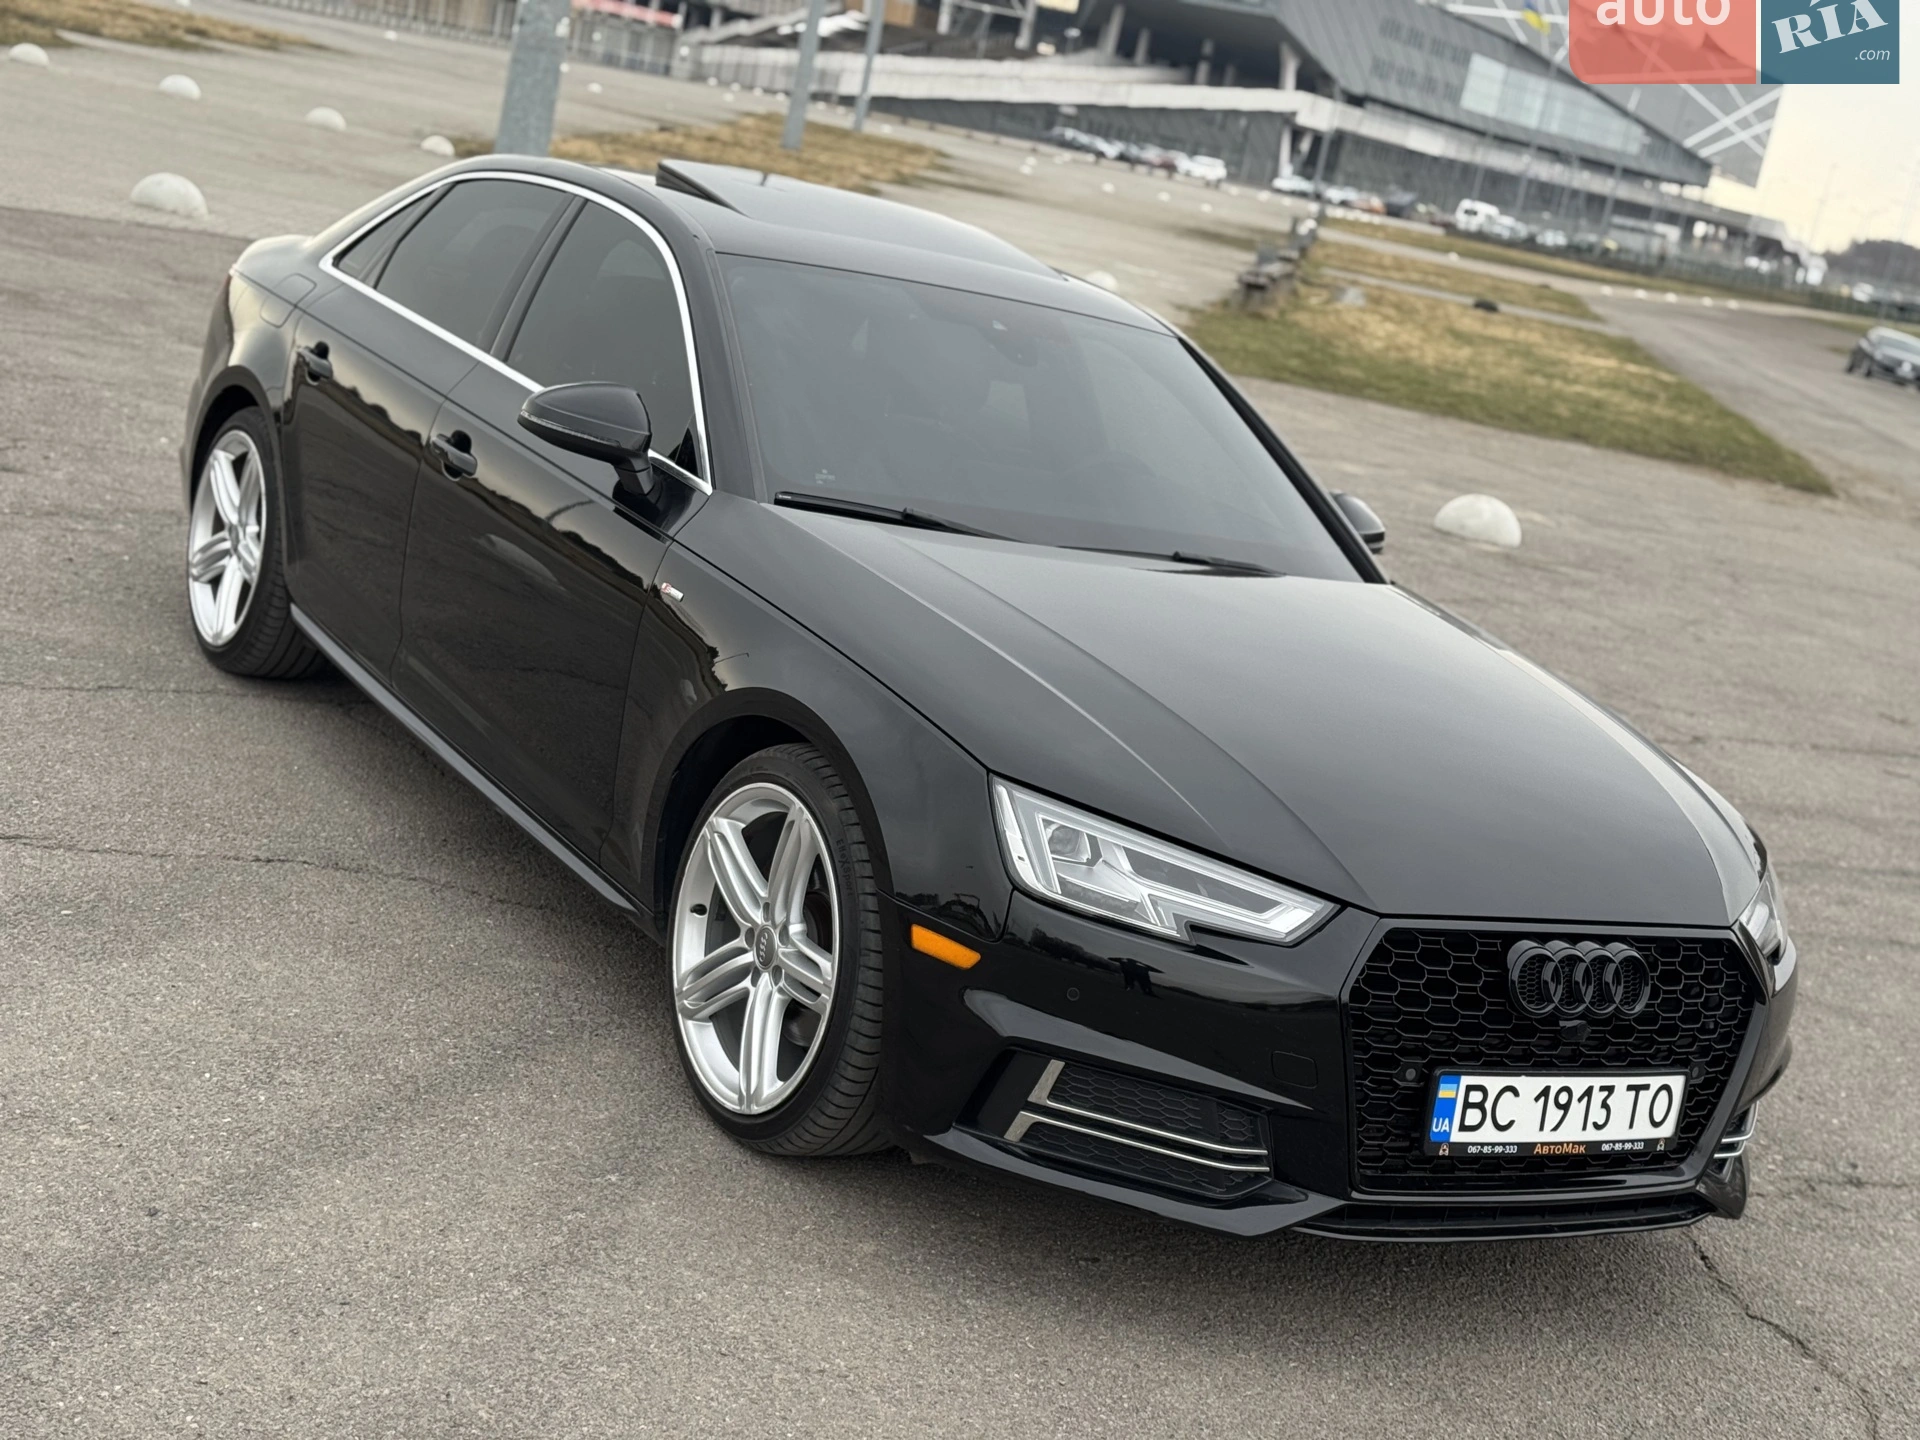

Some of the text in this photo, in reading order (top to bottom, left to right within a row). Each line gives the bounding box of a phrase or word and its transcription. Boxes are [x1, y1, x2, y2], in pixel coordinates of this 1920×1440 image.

[1458, 1083, 1673, 1132] BC 1913 TO
[1432, 1117, 1450, 1133] UA
[1467, 1145, 1518, 1154] 067-85-99-333
[1533, 1143, 1586, 1155] АвтоМак
[1601, 1141, 1644, 1152] 067-85-99-333
